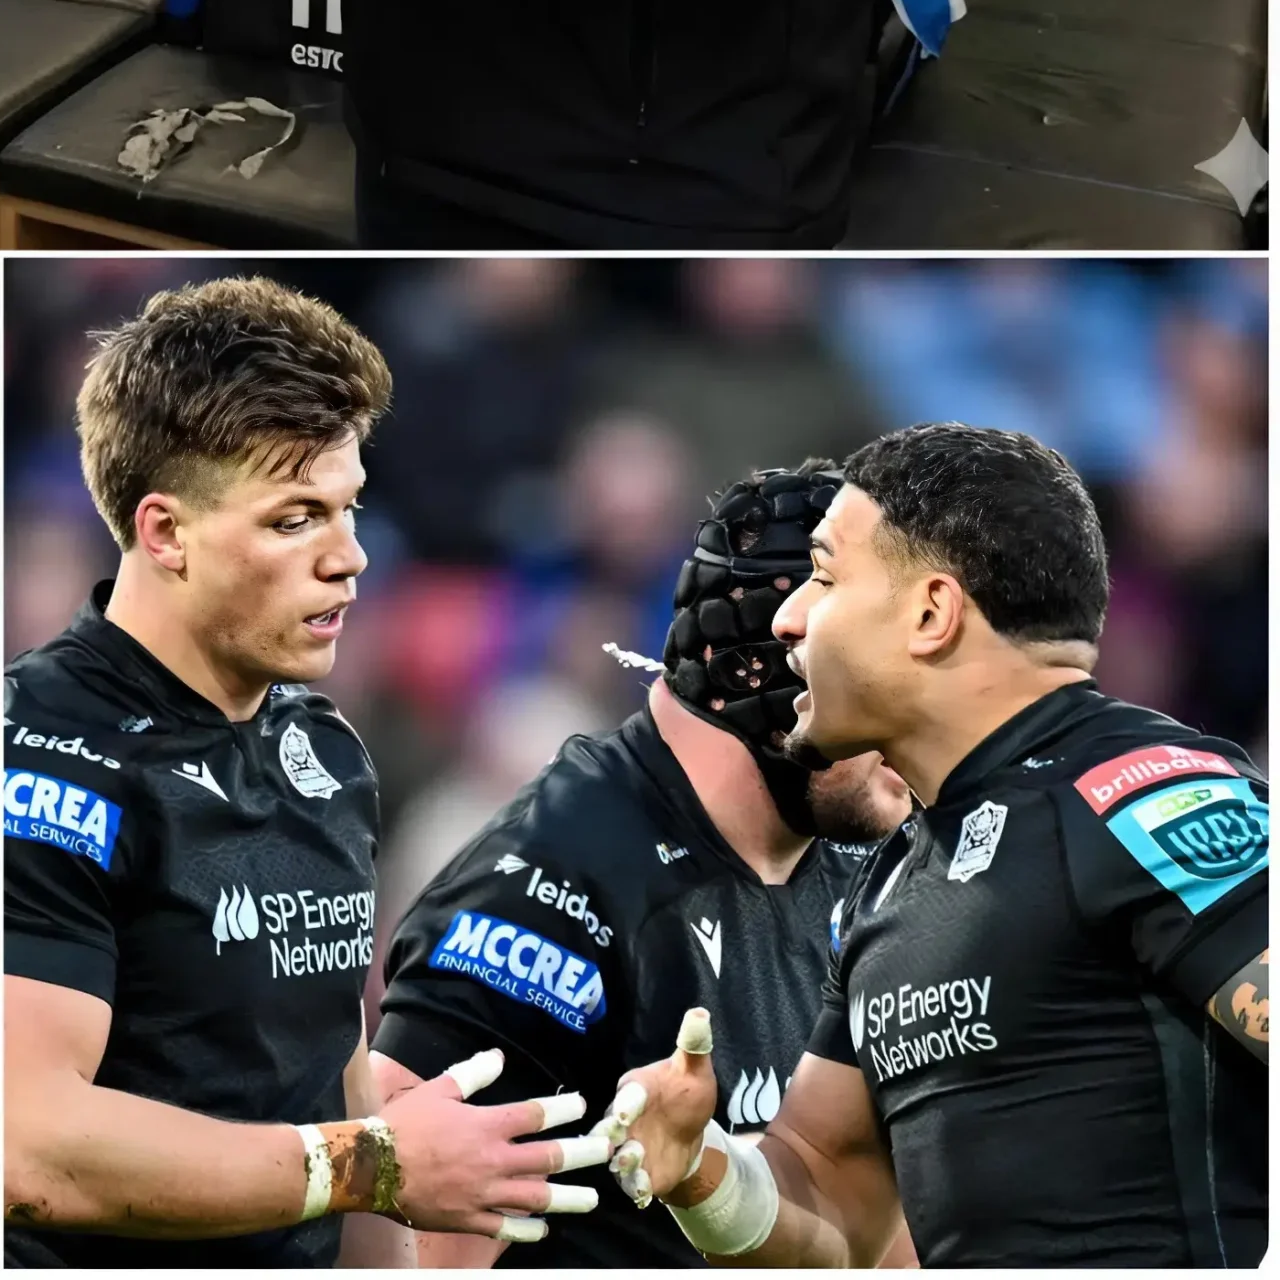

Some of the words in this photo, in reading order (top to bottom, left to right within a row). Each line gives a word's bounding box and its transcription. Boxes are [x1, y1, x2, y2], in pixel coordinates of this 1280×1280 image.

[3, 770, 108, 849] CREA
[260, 892, 298, 934] SP
[297, 889, 376, 931] Energy
[526, 866, 614, 948] leidos
[269, 926, 374, 979] Networks
[436, 952, 520, 997] FINANCIAL
[444, 914, 604, 1015] MCCREA
[867, 992, 895, 1039] SP
[898, 975, 992, 1027] Energy
[870, 1015, 999, 1083] Networks
